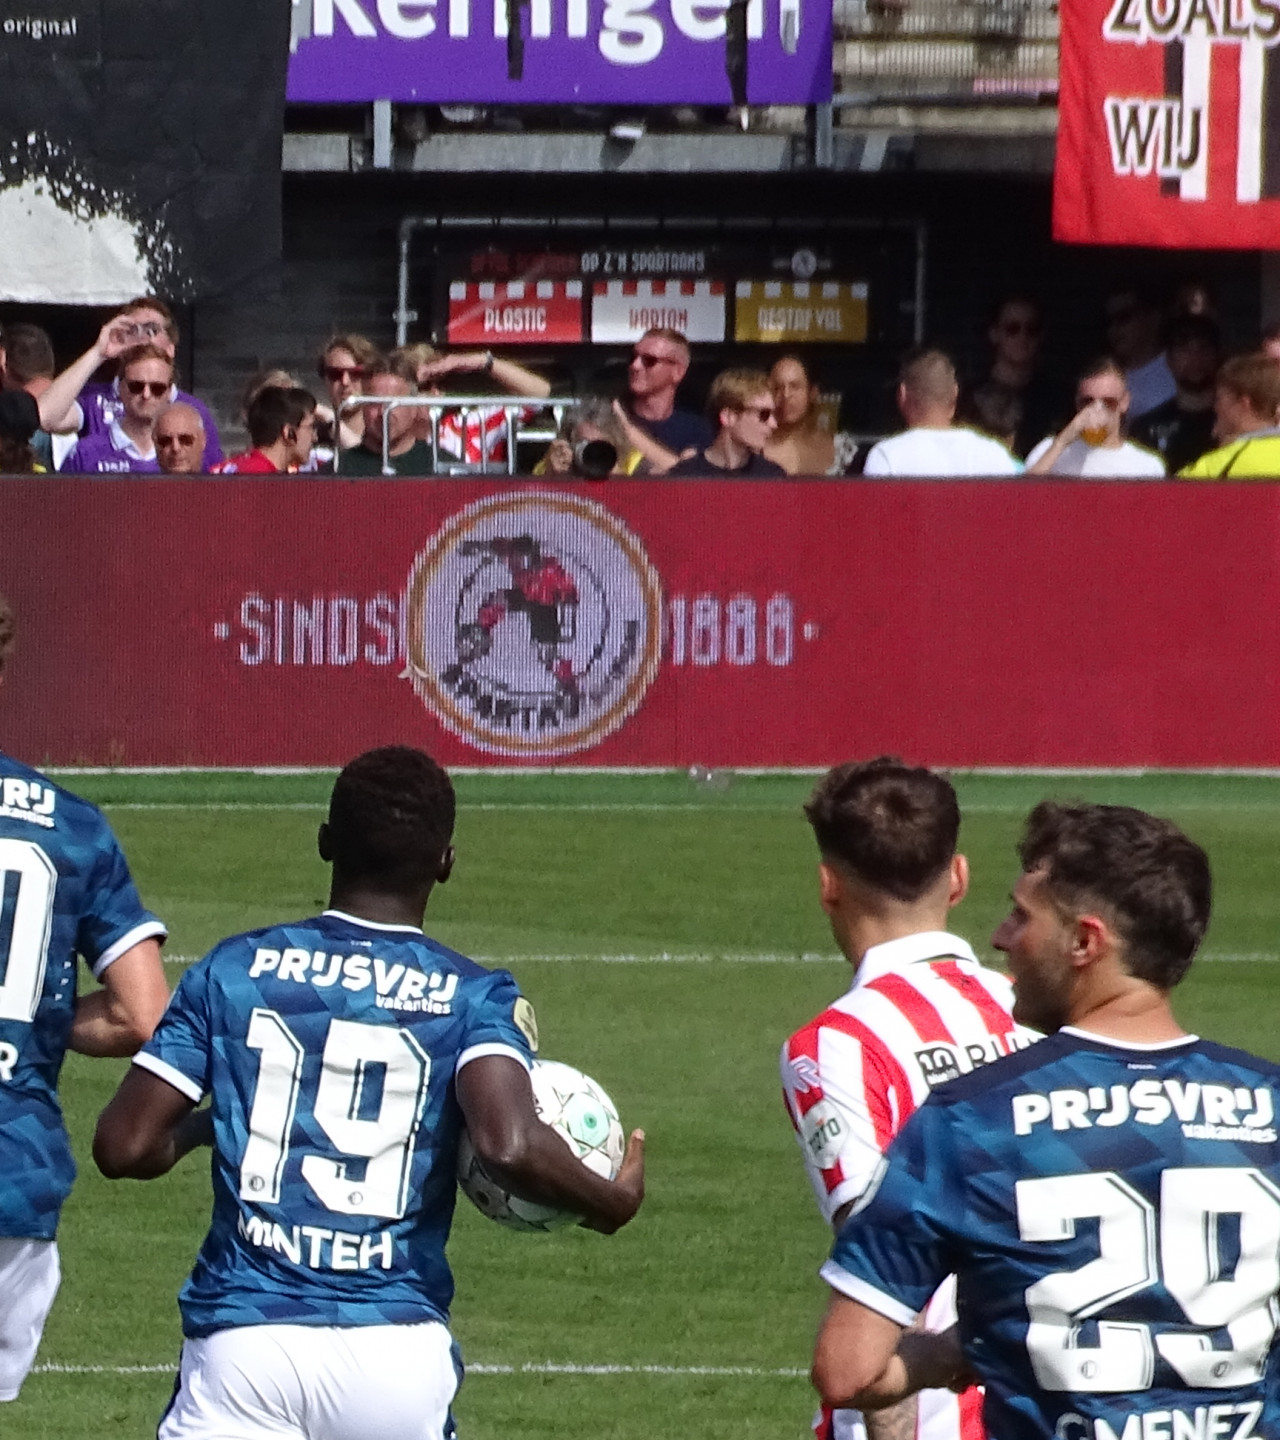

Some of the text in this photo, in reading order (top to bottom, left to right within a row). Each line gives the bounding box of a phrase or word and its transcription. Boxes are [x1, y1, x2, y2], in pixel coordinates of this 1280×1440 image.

[3, 15, 78, 40] original
[1109, 101, 1204, 173] WIJ
[483, 306, 548, 333] PLASTIC
[375, 994, 453, 1016] vakanties
[240, 1007, 433, 1220] 19
[1015, 1166, 1280, 1393] 29
